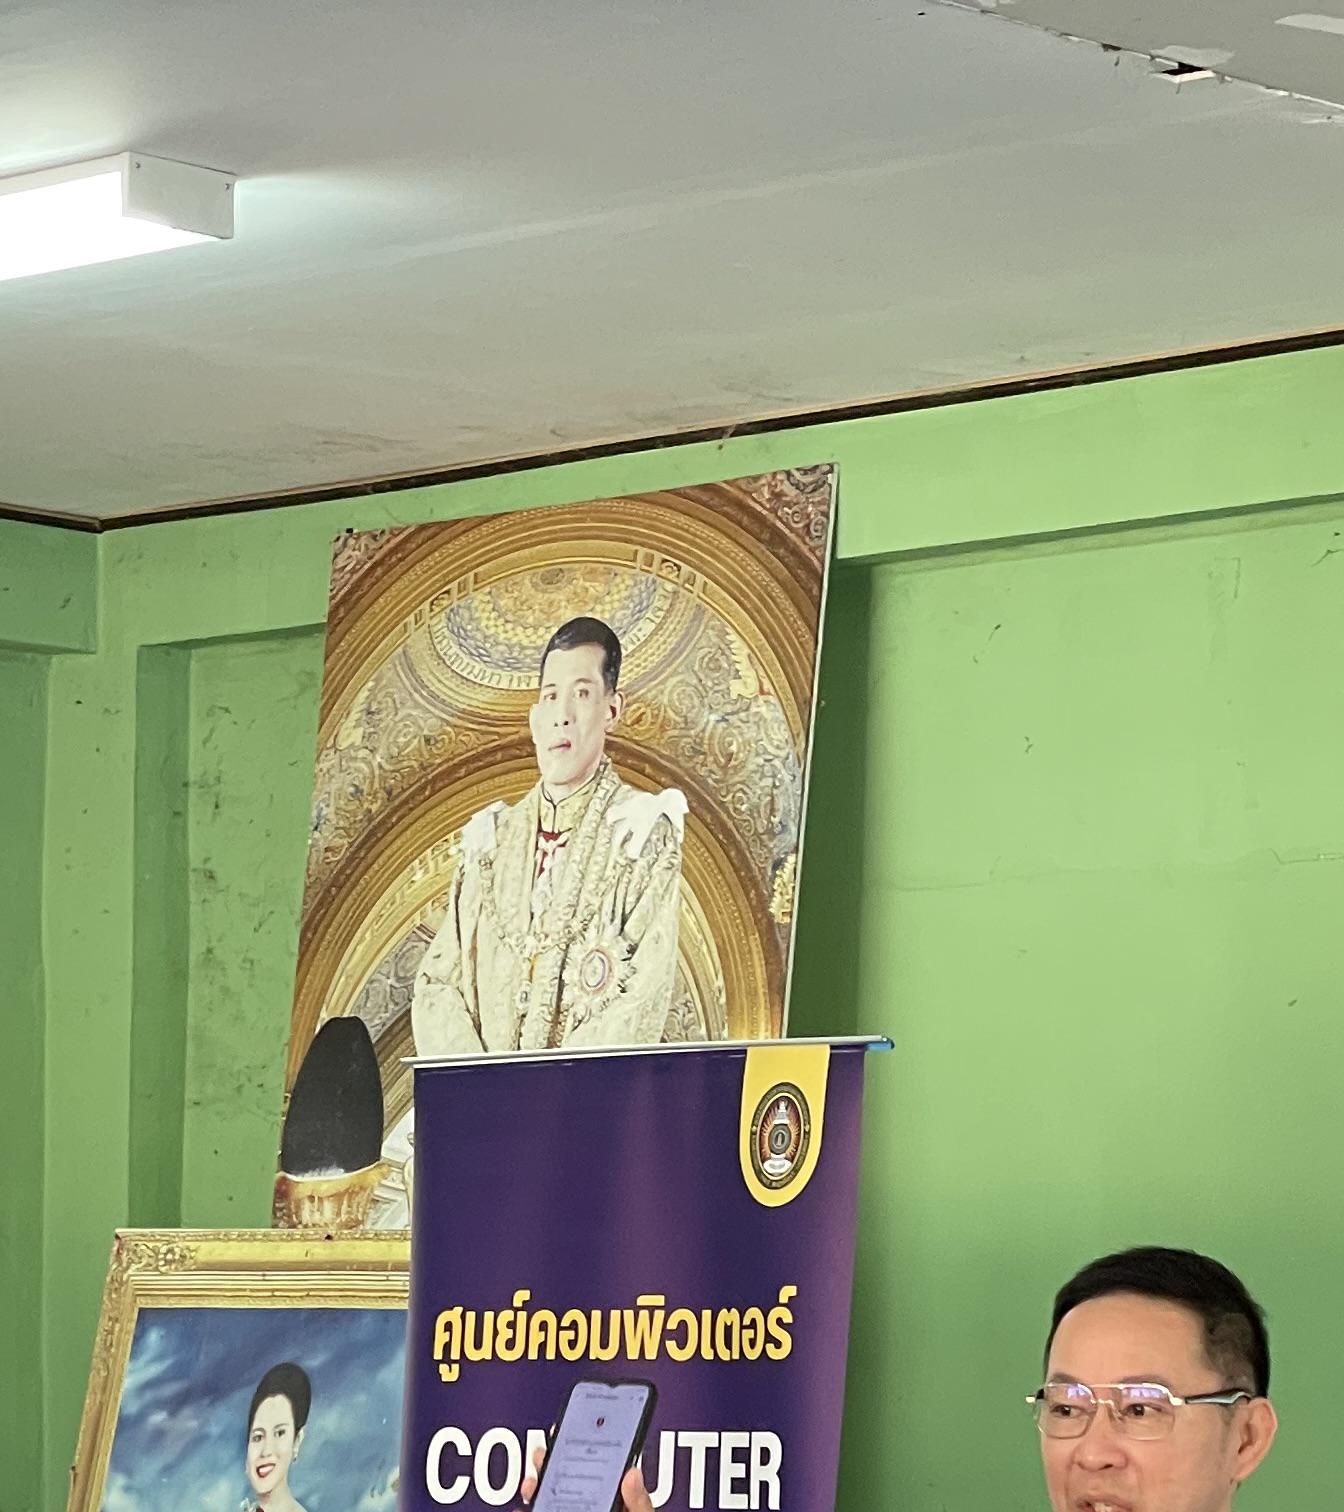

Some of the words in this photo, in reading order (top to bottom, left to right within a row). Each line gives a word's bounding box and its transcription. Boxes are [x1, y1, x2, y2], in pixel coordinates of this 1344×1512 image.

[432, 1285, 798, 1382] ศูนย์คอมพิวเตอร์
[425, 1426, 783, 1510] COUTER
